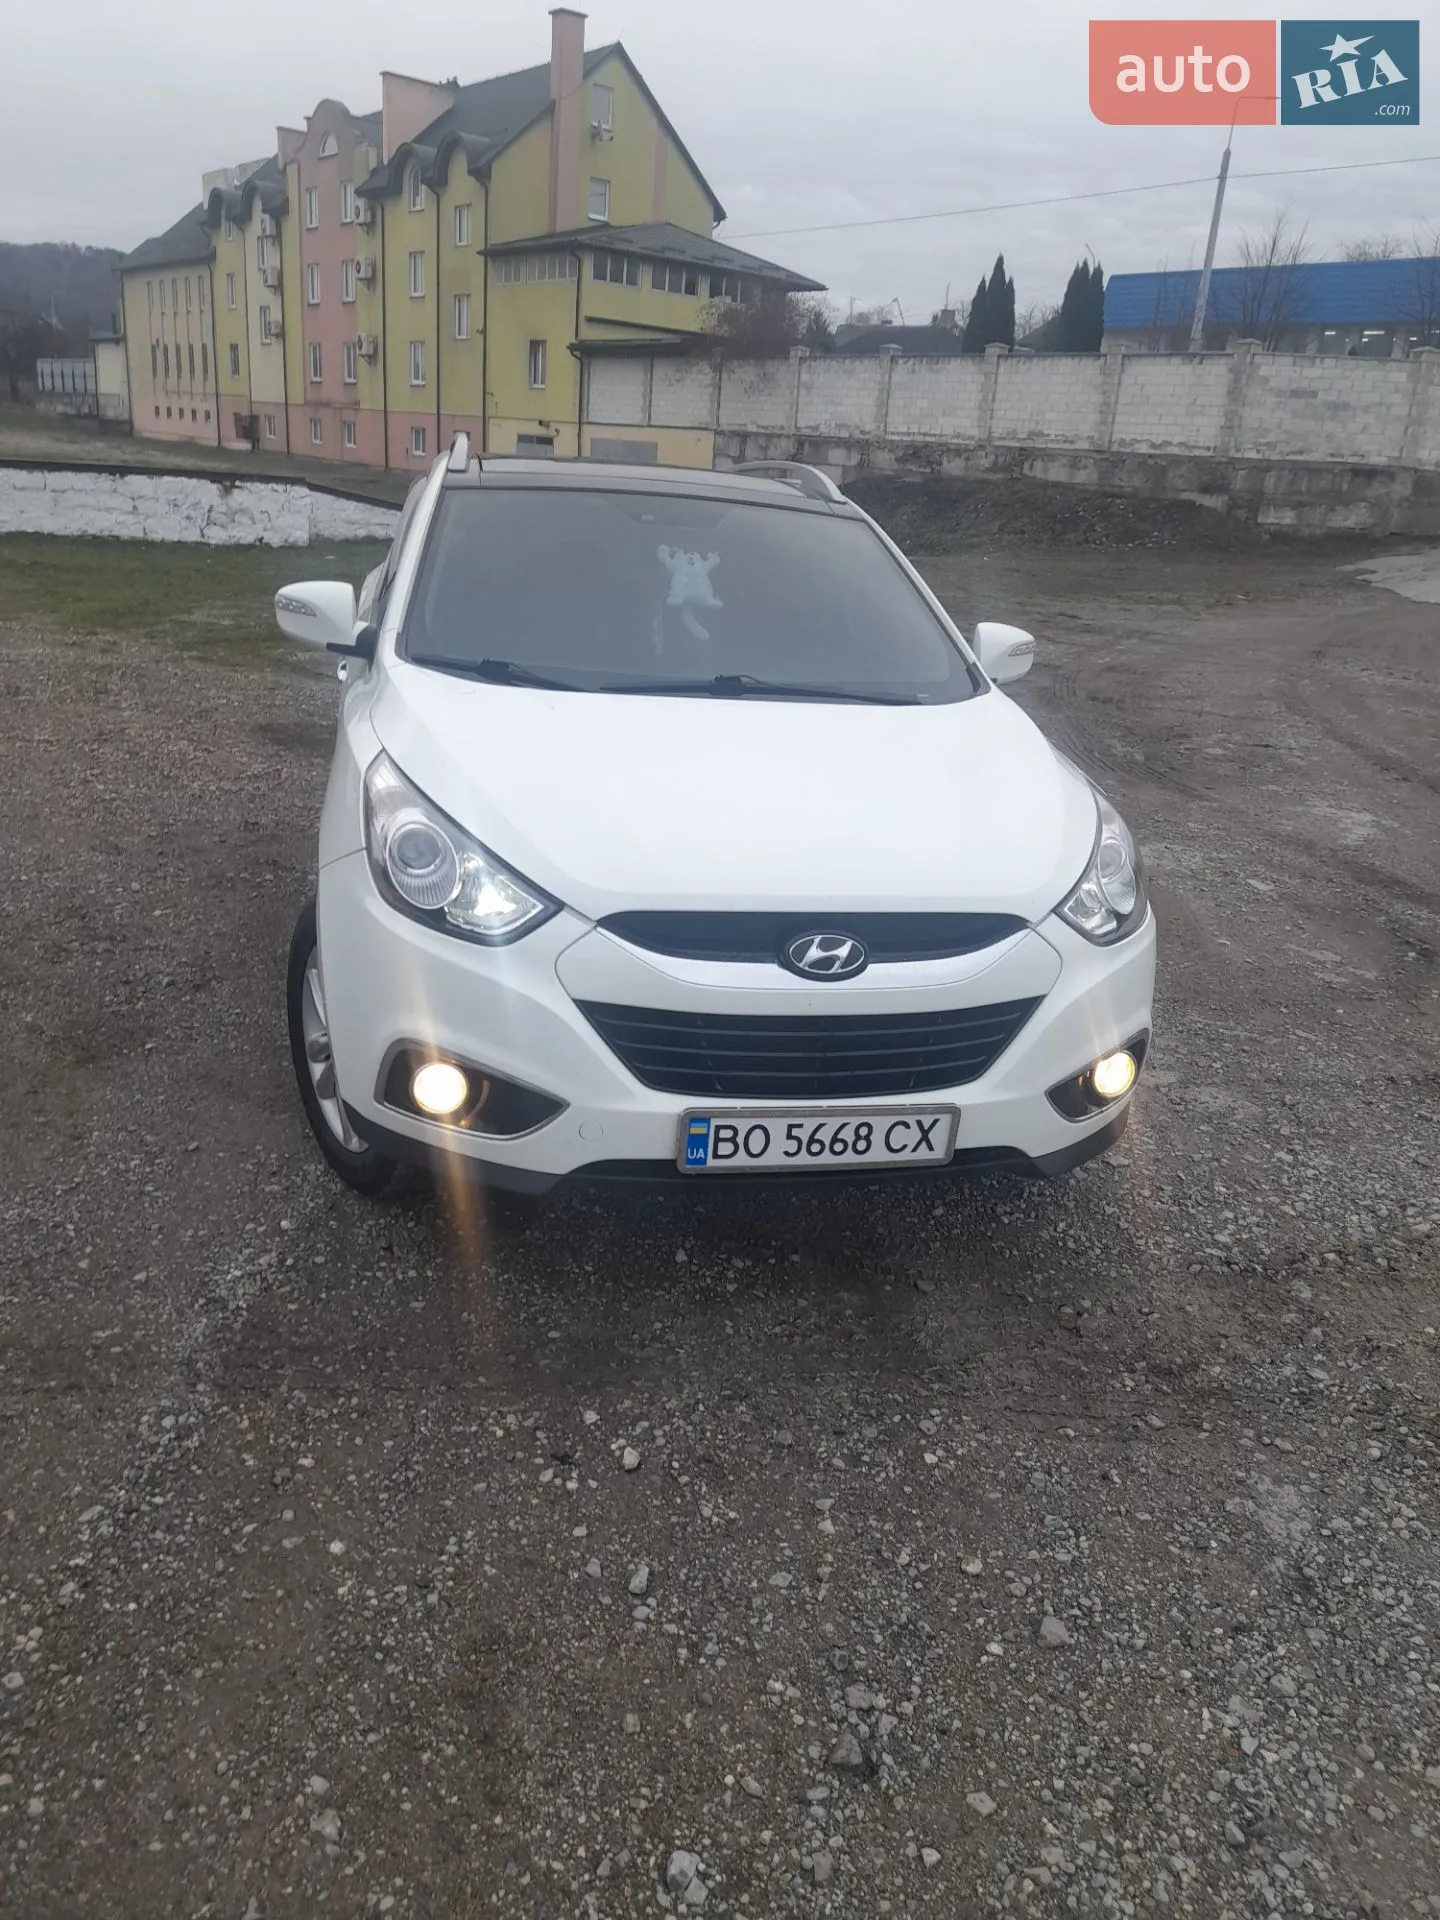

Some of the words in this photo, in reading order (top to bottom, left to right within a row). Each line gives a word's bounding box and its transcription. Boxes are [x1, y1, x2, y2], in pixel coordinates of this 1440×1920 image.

[711, 1124, 771, 1160] BO
[782, 1122, 874, 1157] 5668
[884, 1118, 940, 1153] CX
[687, 1147, 705, 1160] UA
